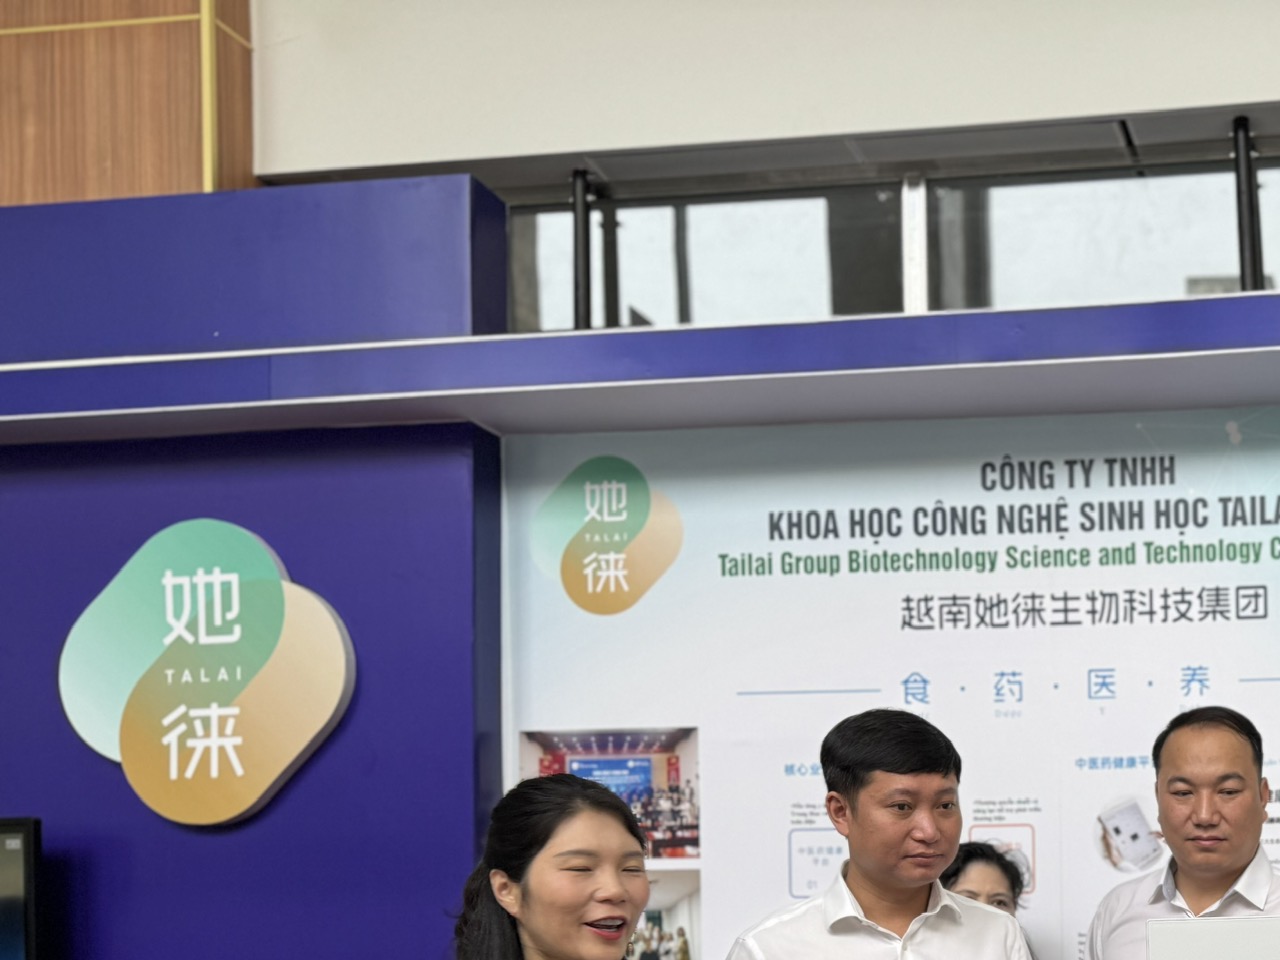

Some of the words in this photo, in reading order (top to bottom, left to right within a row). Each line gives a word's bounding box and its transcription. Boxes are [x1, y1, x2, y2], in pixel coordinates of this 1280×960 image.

[981, 454, 1054, 491] CÔNG
[1065, 459, 1094, 488] TY
[1104, 455, 1175, 487] TNHH
[585, 532, 627, 542] TALAI
[769, 509, 839, 541] KHOA
[850, 507, 902, 544] HỌC
[913, 499, 987, 536] CÔNG
[997, 496, 1069, 540] NGHỆ
[1080, 500, 1144, 532] SINH
[1155, 497, 1208, 535] HỌC
[718, 552, 773, 577] Tailai
[780, 551, 840, 577] Group
[848, 547, 998, 573] Biotechnology
[1006, 545, 1091, 569] Science
[1099, 542, 1136, 566] and
[1143, 538, 1262, 565] Technology
[161, 566, 241, 646] 她
[901, 585, 1268, 631] 越南她徕生物科技集团
[164, 666, 242, 685] TALAI
